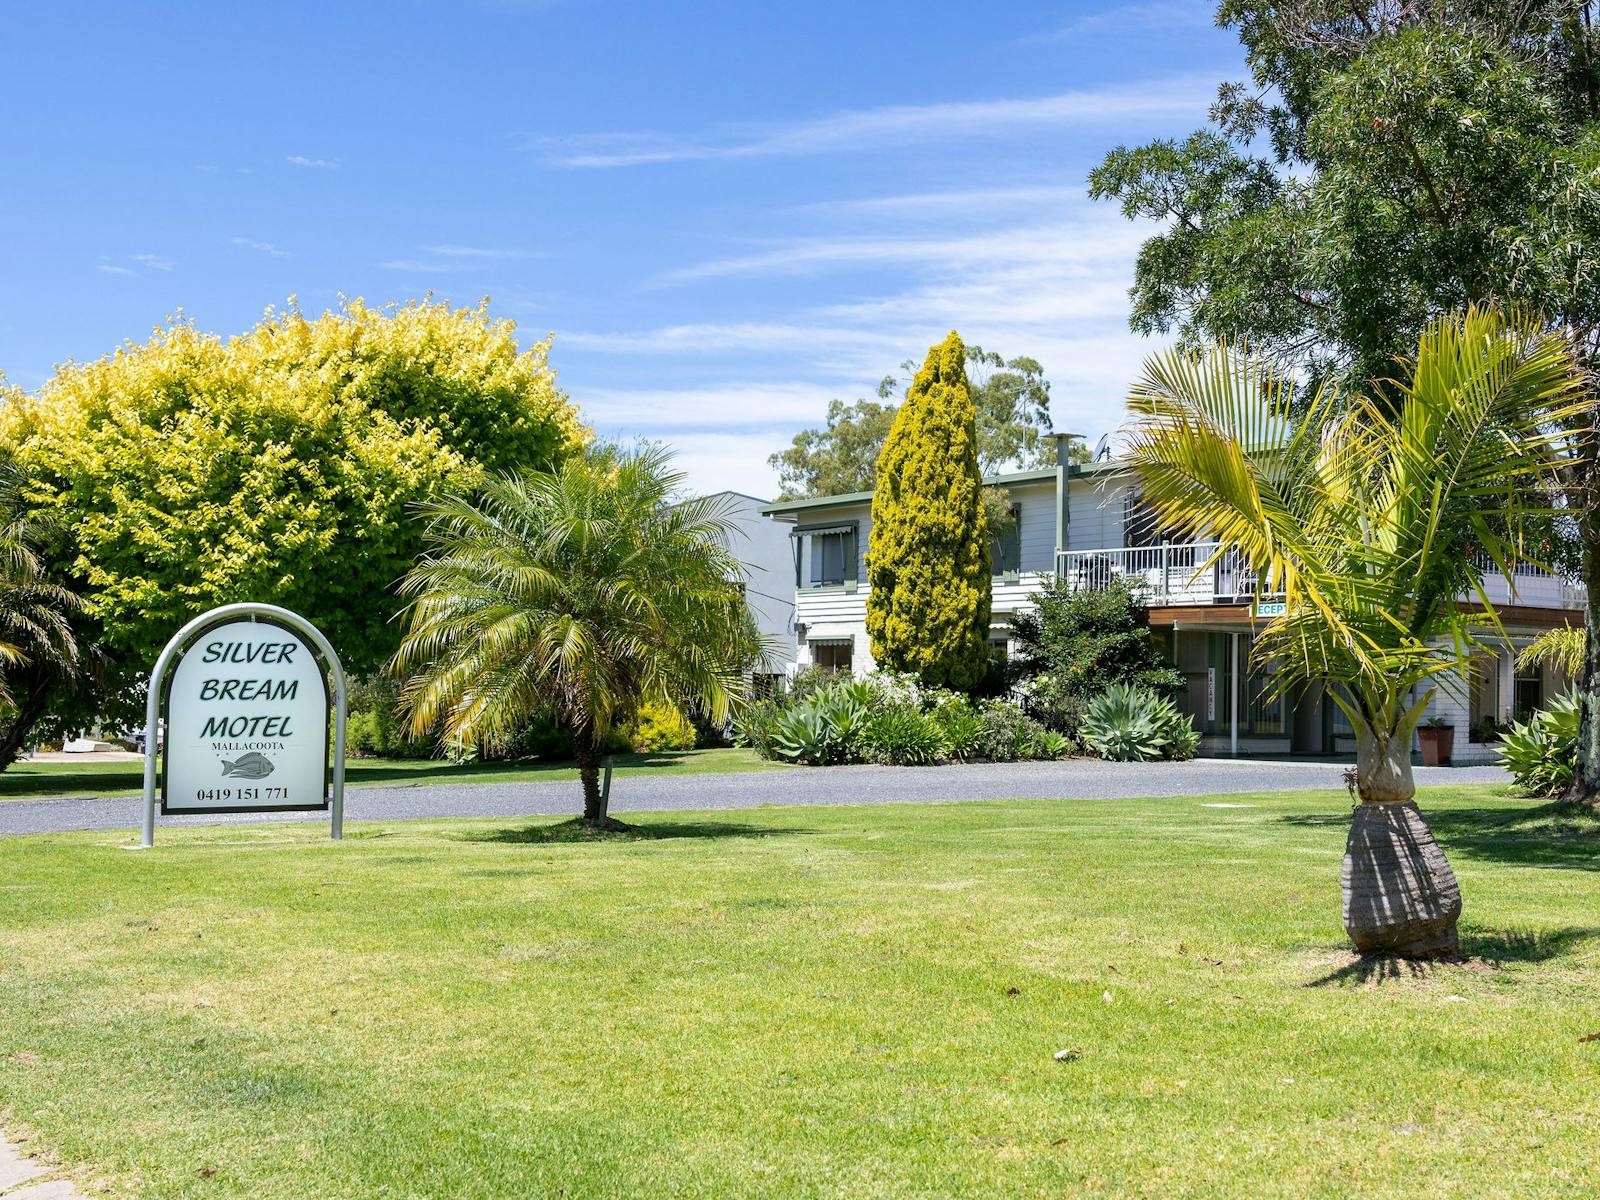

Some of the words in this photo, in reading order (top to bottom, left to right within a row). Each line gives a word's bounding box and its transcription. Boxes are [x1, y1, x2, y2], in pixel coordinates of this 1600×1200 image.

[202, 642, 298, 664] SILVER
[199, 679, 299, 701] BREAM
[199, 716, 293, 738] MOTEL
[212, 742, 284, 750] MALLACOOTA
[197, 789, 231, 800] 0419
[237, 788, 259, 800] 151
[265, 787, 288, 799] 771
